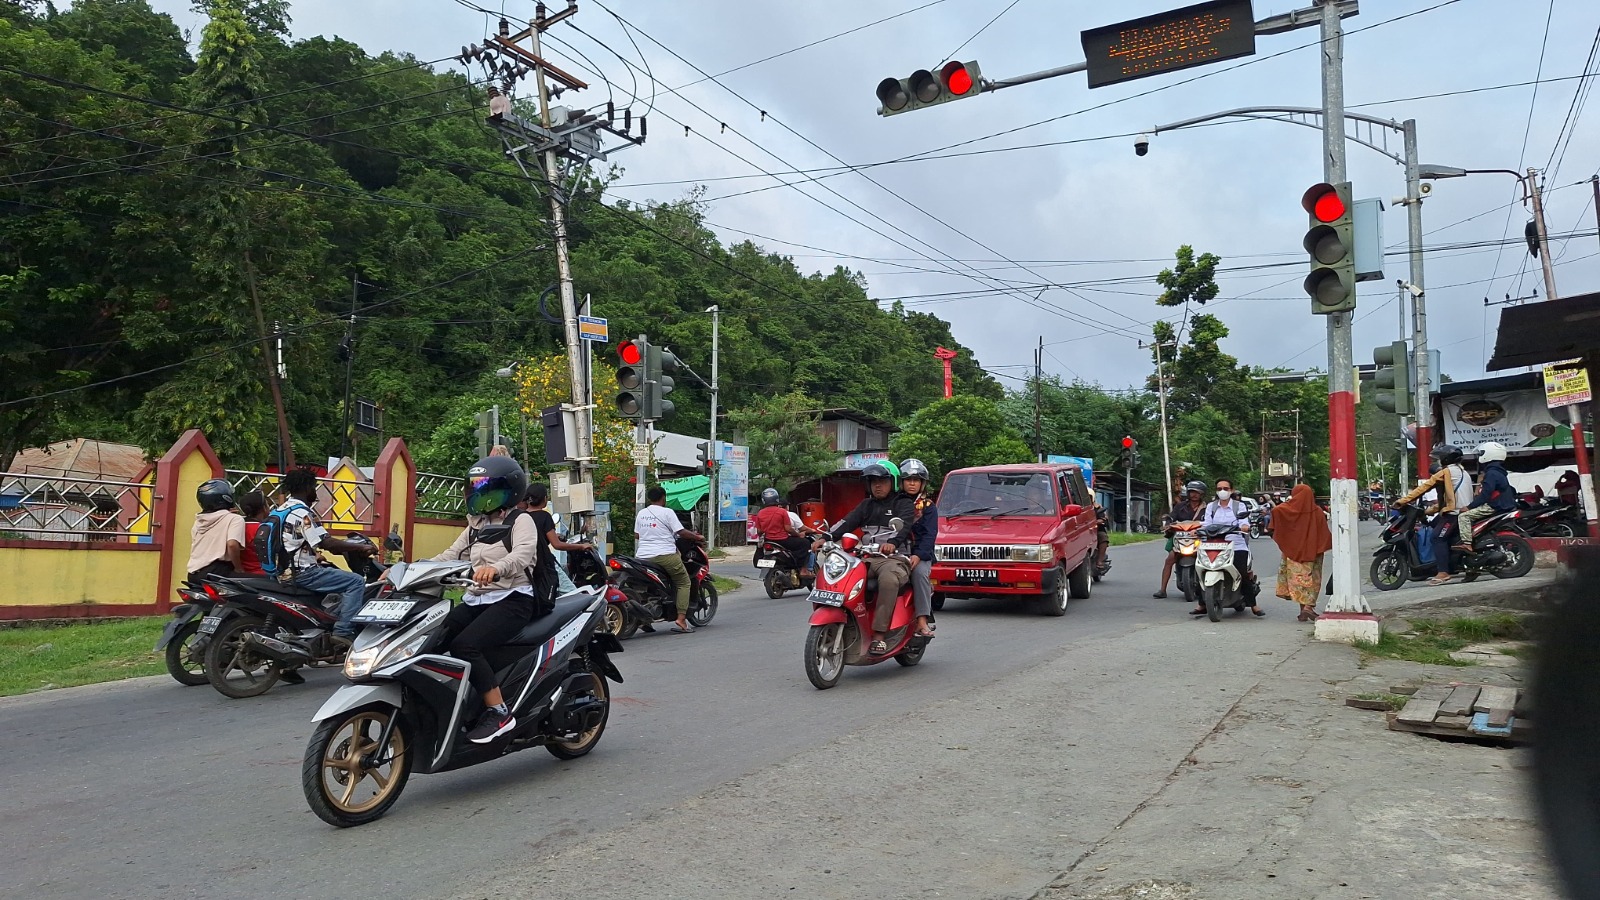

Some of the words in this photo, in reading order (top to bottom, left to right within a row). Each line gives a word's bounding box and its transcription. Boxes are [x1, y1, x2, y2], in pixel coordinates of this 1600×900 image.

[955, 569, 964, 577] PA
[966, 569, 984, 578] 1230
[364, 602, 377, 610] PA
[378, 602, 400, 610] 3790
[426, 609, 445, 622] YAMAHA
